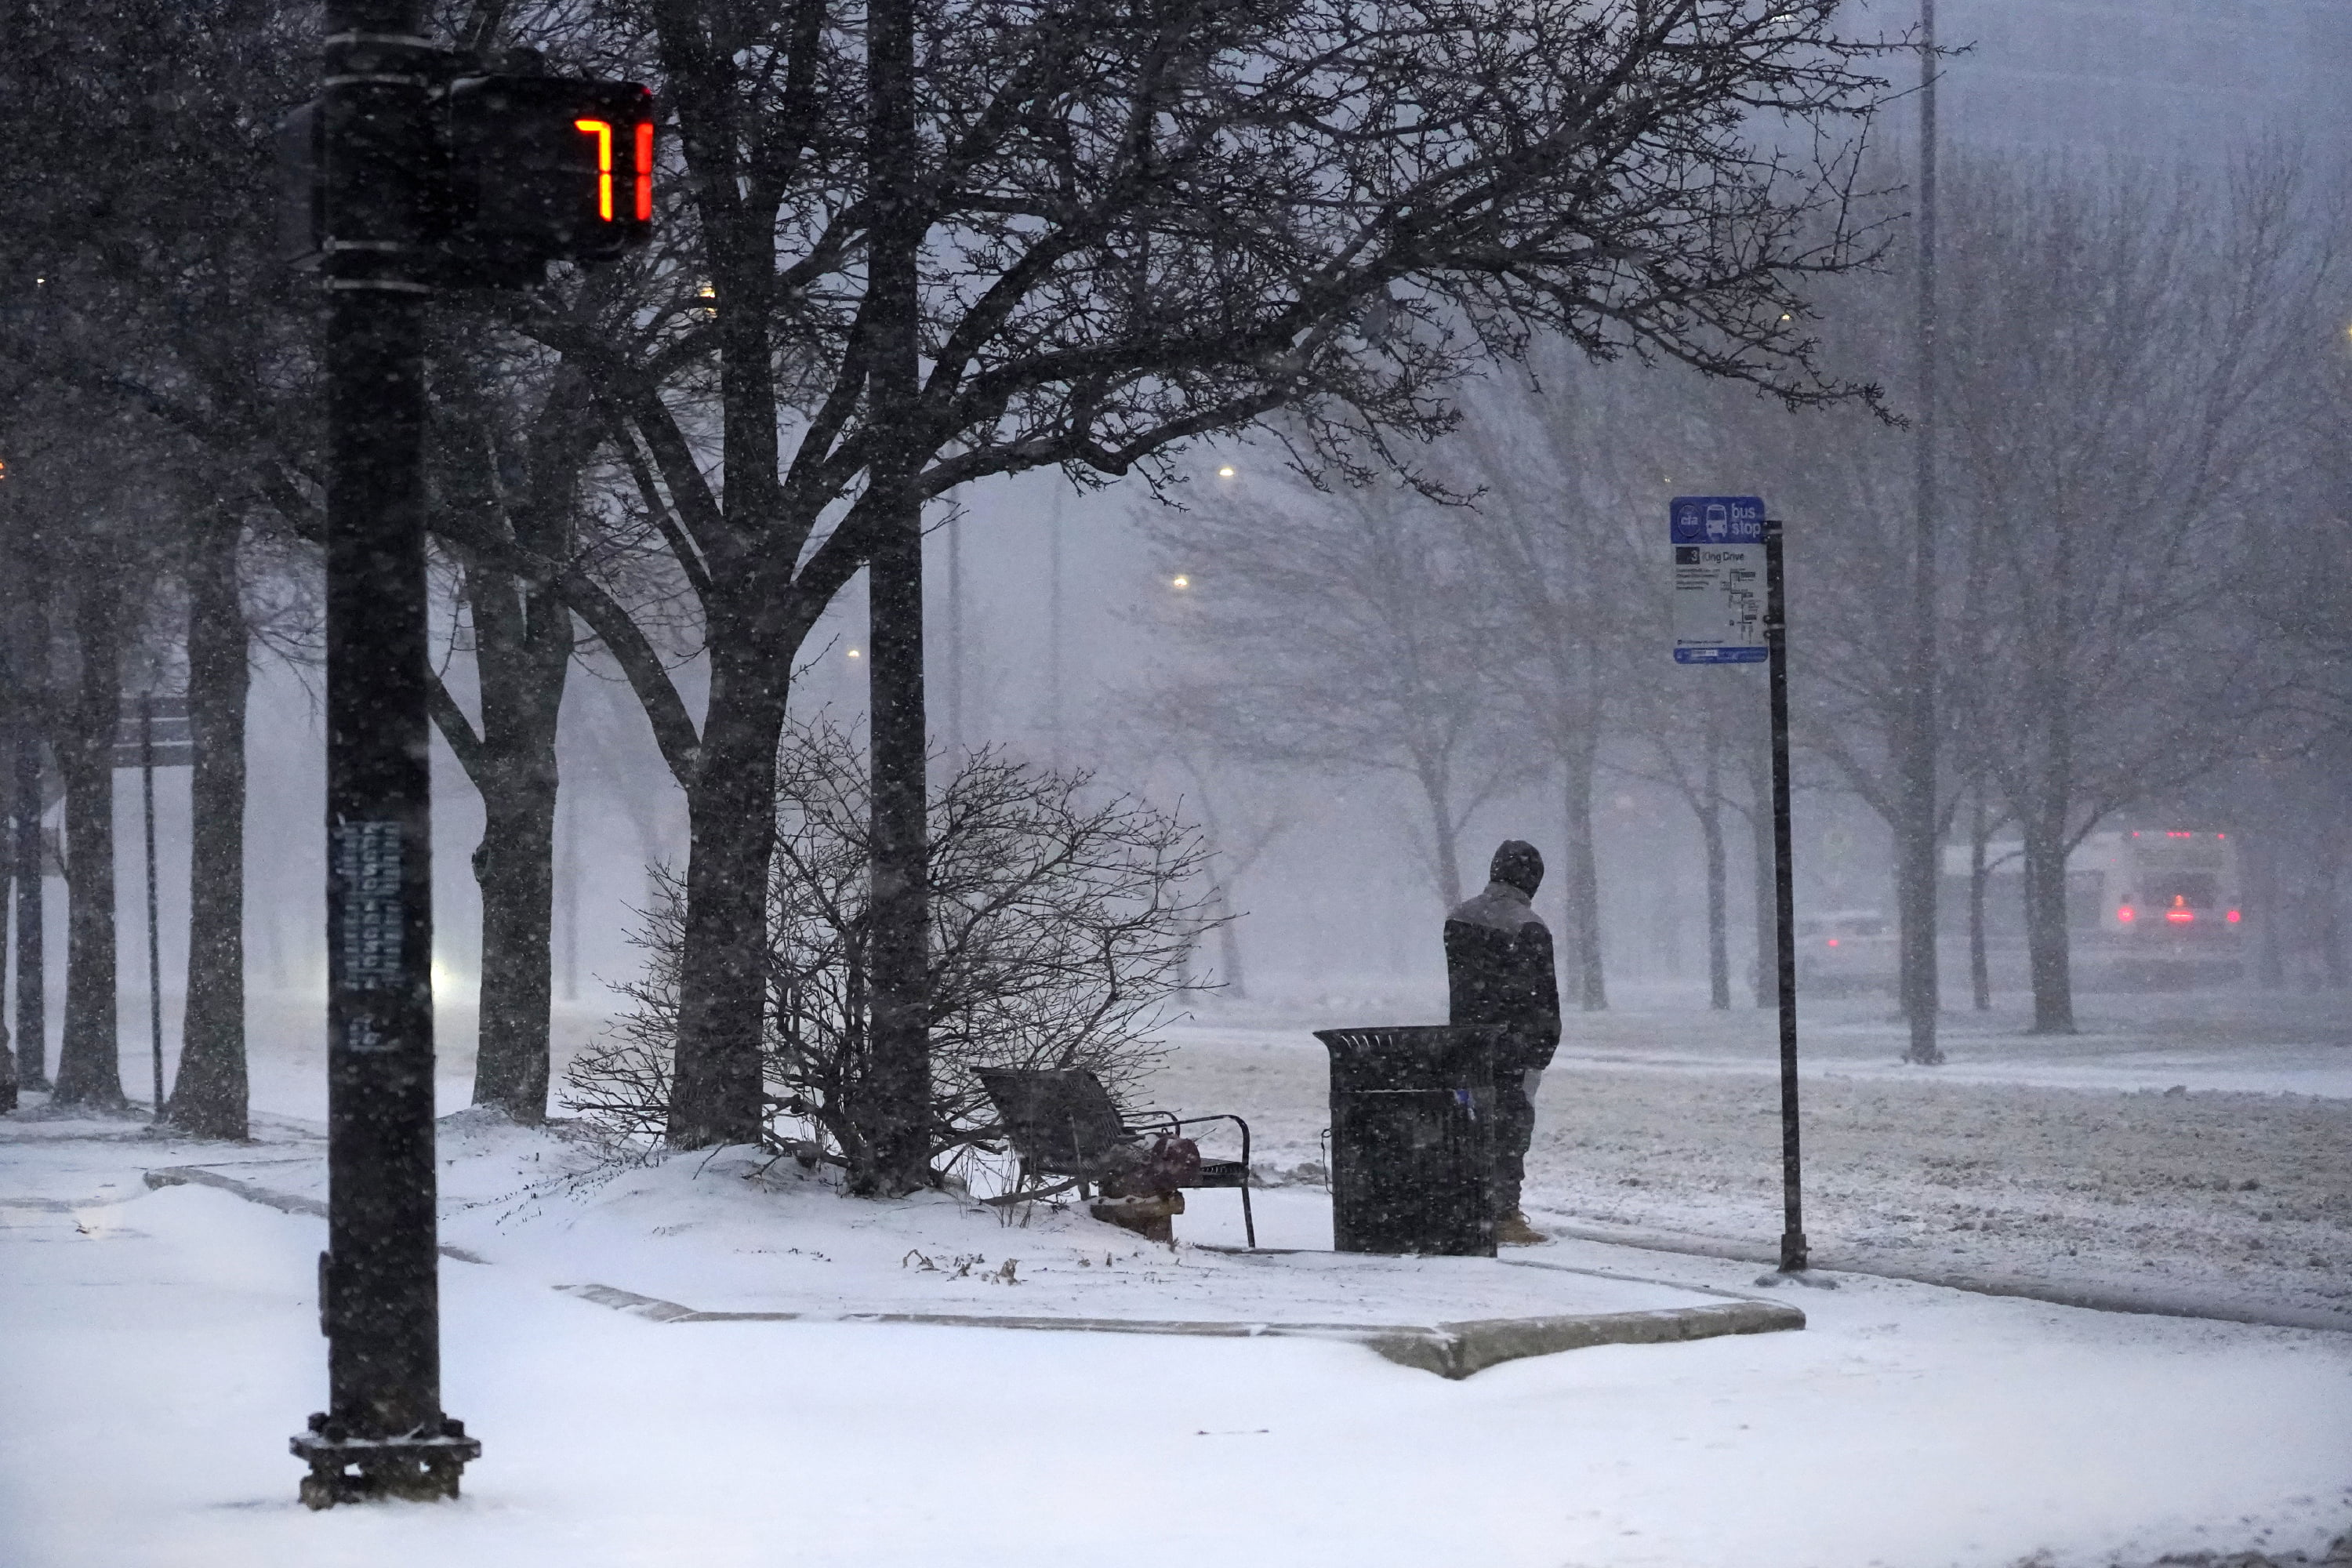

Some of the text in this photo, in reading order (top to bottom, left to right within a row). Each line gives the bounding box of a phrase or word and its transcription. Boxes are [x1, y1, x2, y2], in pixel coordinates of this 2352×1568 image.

[1731, 503, 1755, 519] bus
[1731, 521, 1761, 539] stop
[1690, 550, 1698, 562] 3
[1723, 551, 1744, 561] Drive
